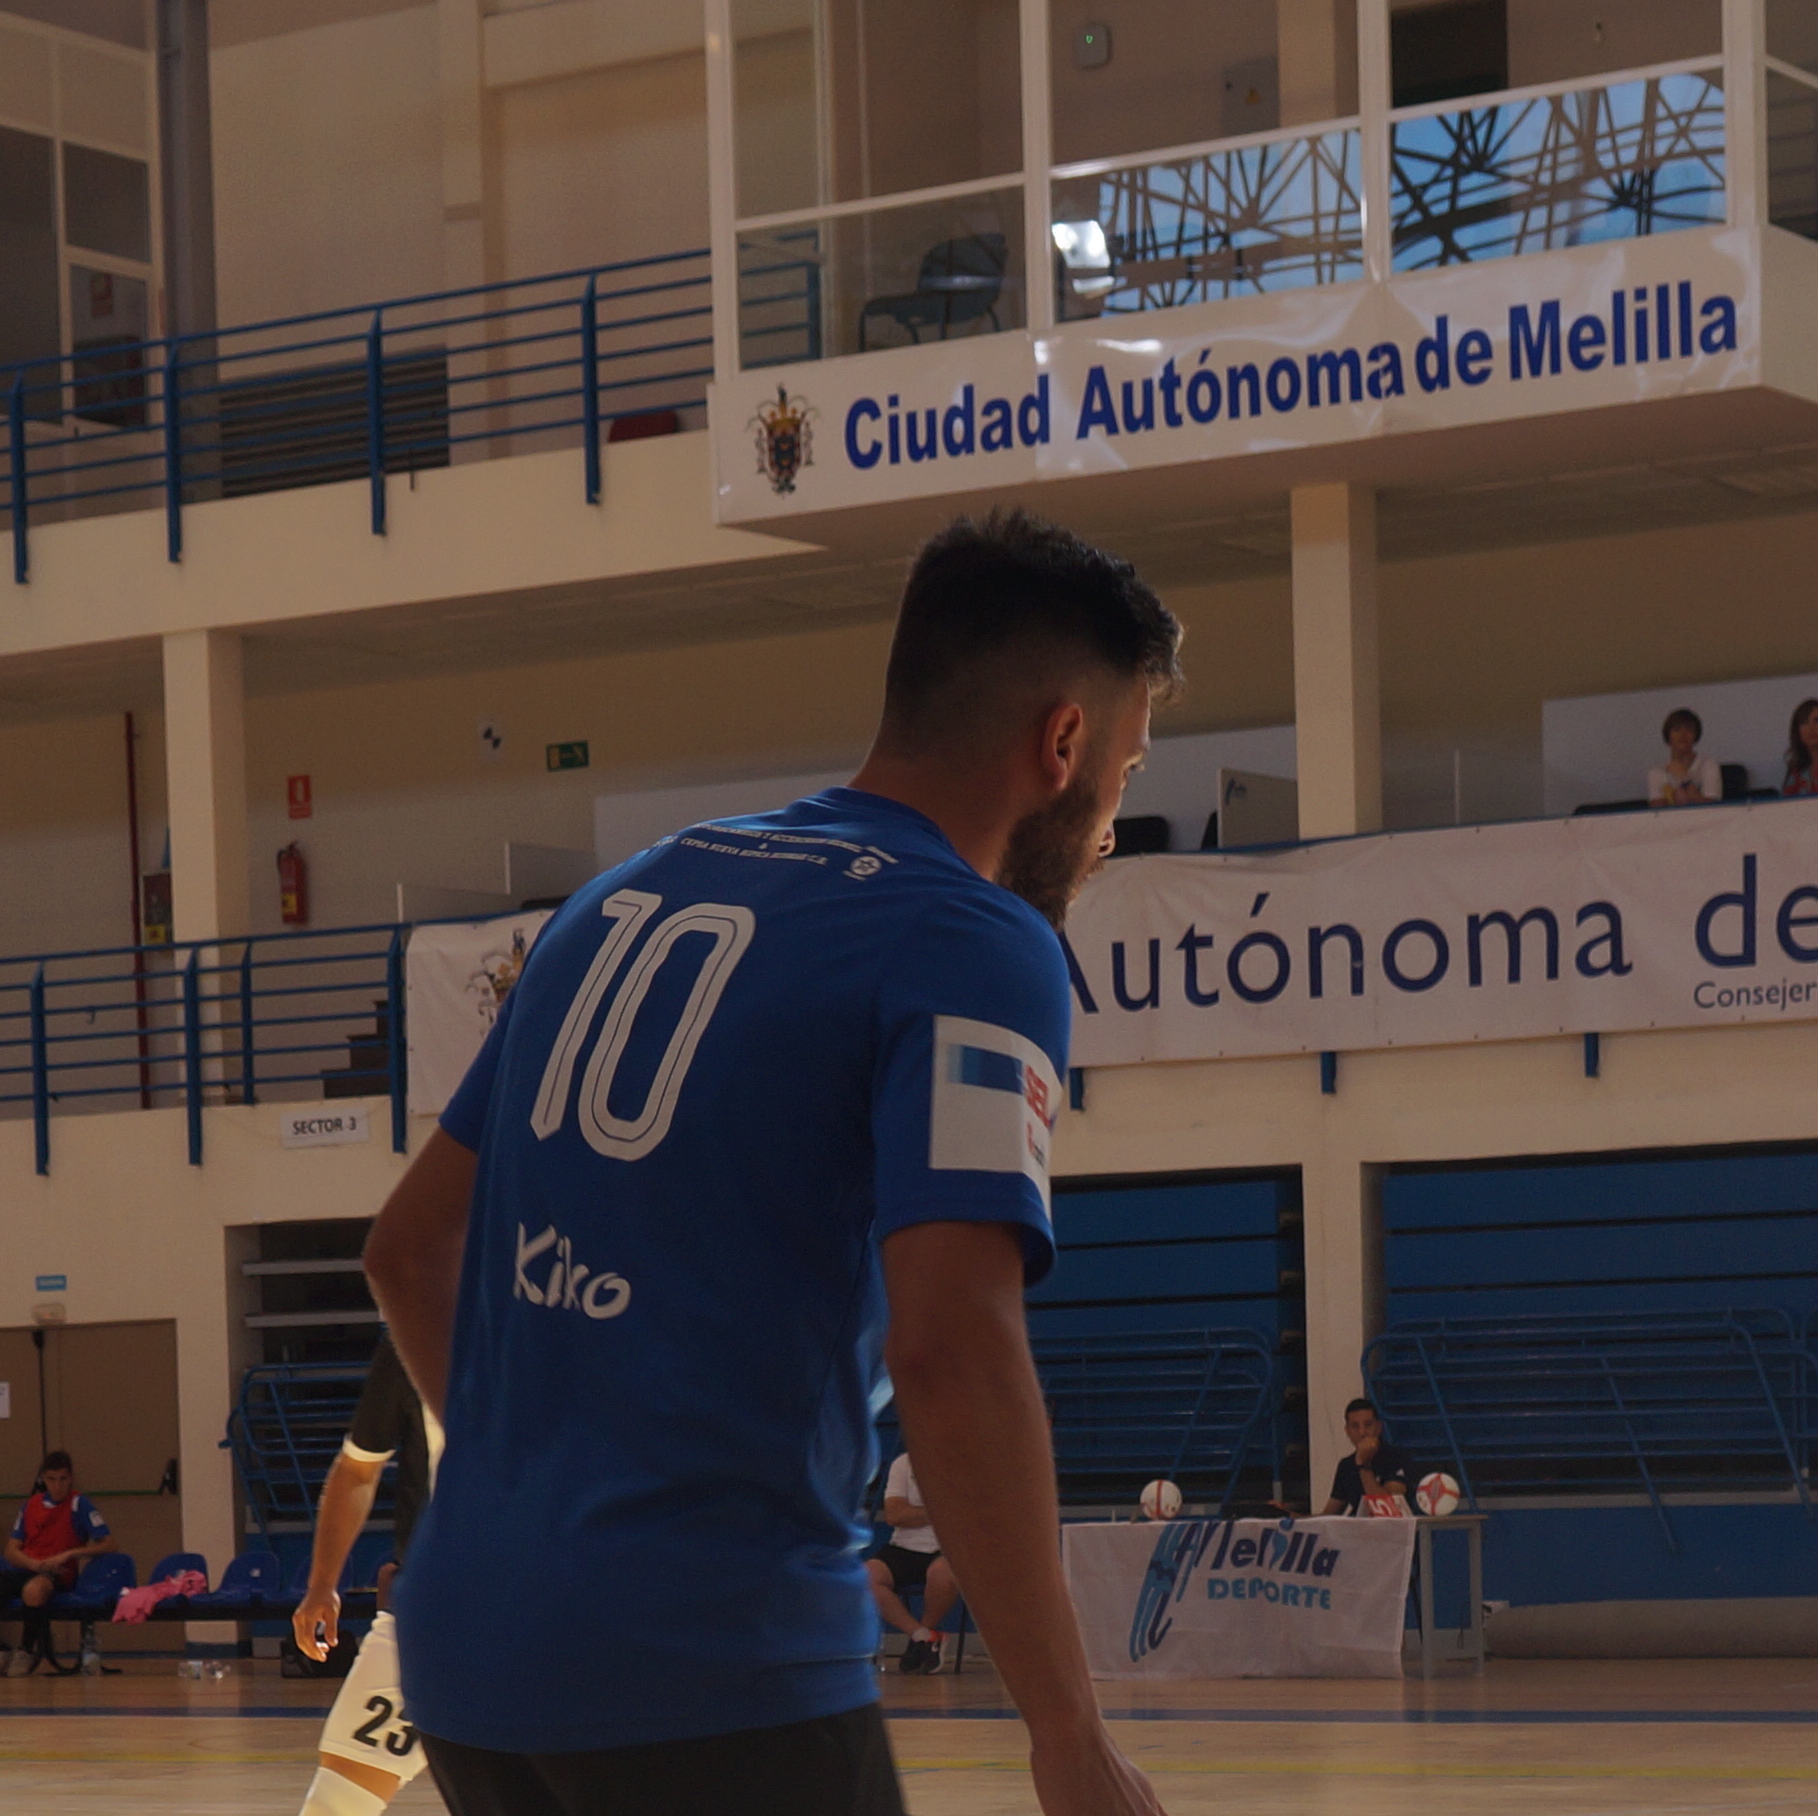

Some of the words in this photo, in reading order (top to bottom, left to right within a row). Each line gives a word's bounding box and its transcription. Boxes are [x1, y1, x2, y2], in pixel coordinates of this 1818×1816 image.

[845, 372, 1052, 471] Ciudad
[1074, 335, 1406, 441] Autónoma
[1413, 325, 1494, 392] de
[1506, 280, 1739, 381] Melilla
[529, 888, 757, 1163] 10
[292, 1119, 342, 1135] SECTOR
[348, 1117, 357, 1131] 3
[513, 1222, 631, 1320] Kiko
[1207, 1578, 1332, 1610] DEPORTE
